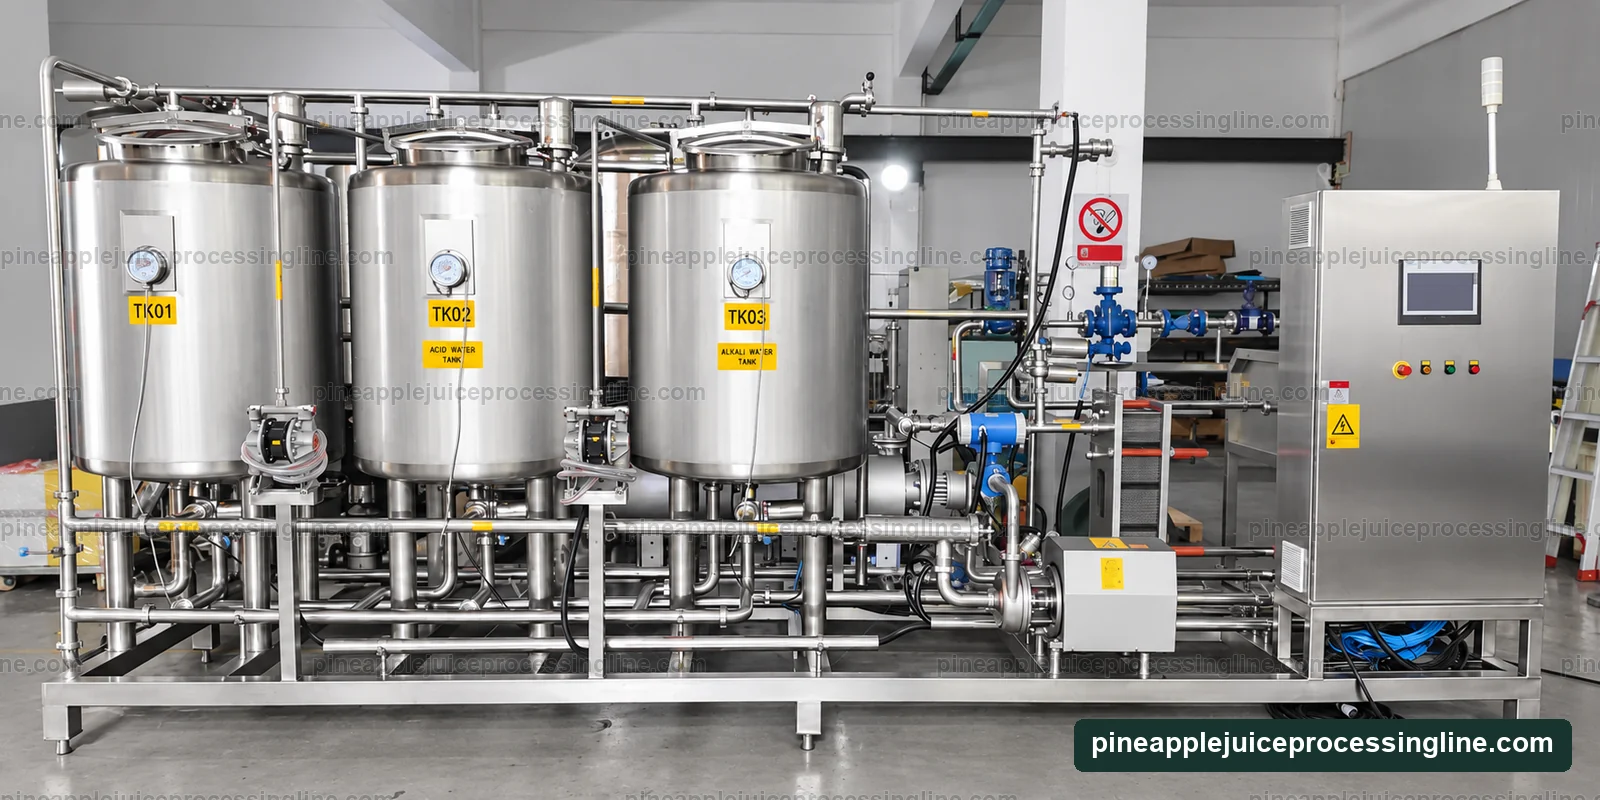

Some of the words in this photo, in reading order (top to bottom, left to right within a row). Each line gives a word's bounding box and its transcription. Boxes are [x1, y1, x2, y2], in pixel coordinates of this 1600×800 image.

[133, 303, 172, 319] TK01
[432, 306, 471, 322] TK02
[728, 309, 766, 325] TK03
[429, 346, 447, 354] ACID
[450, 346, 476, 354] WATER
